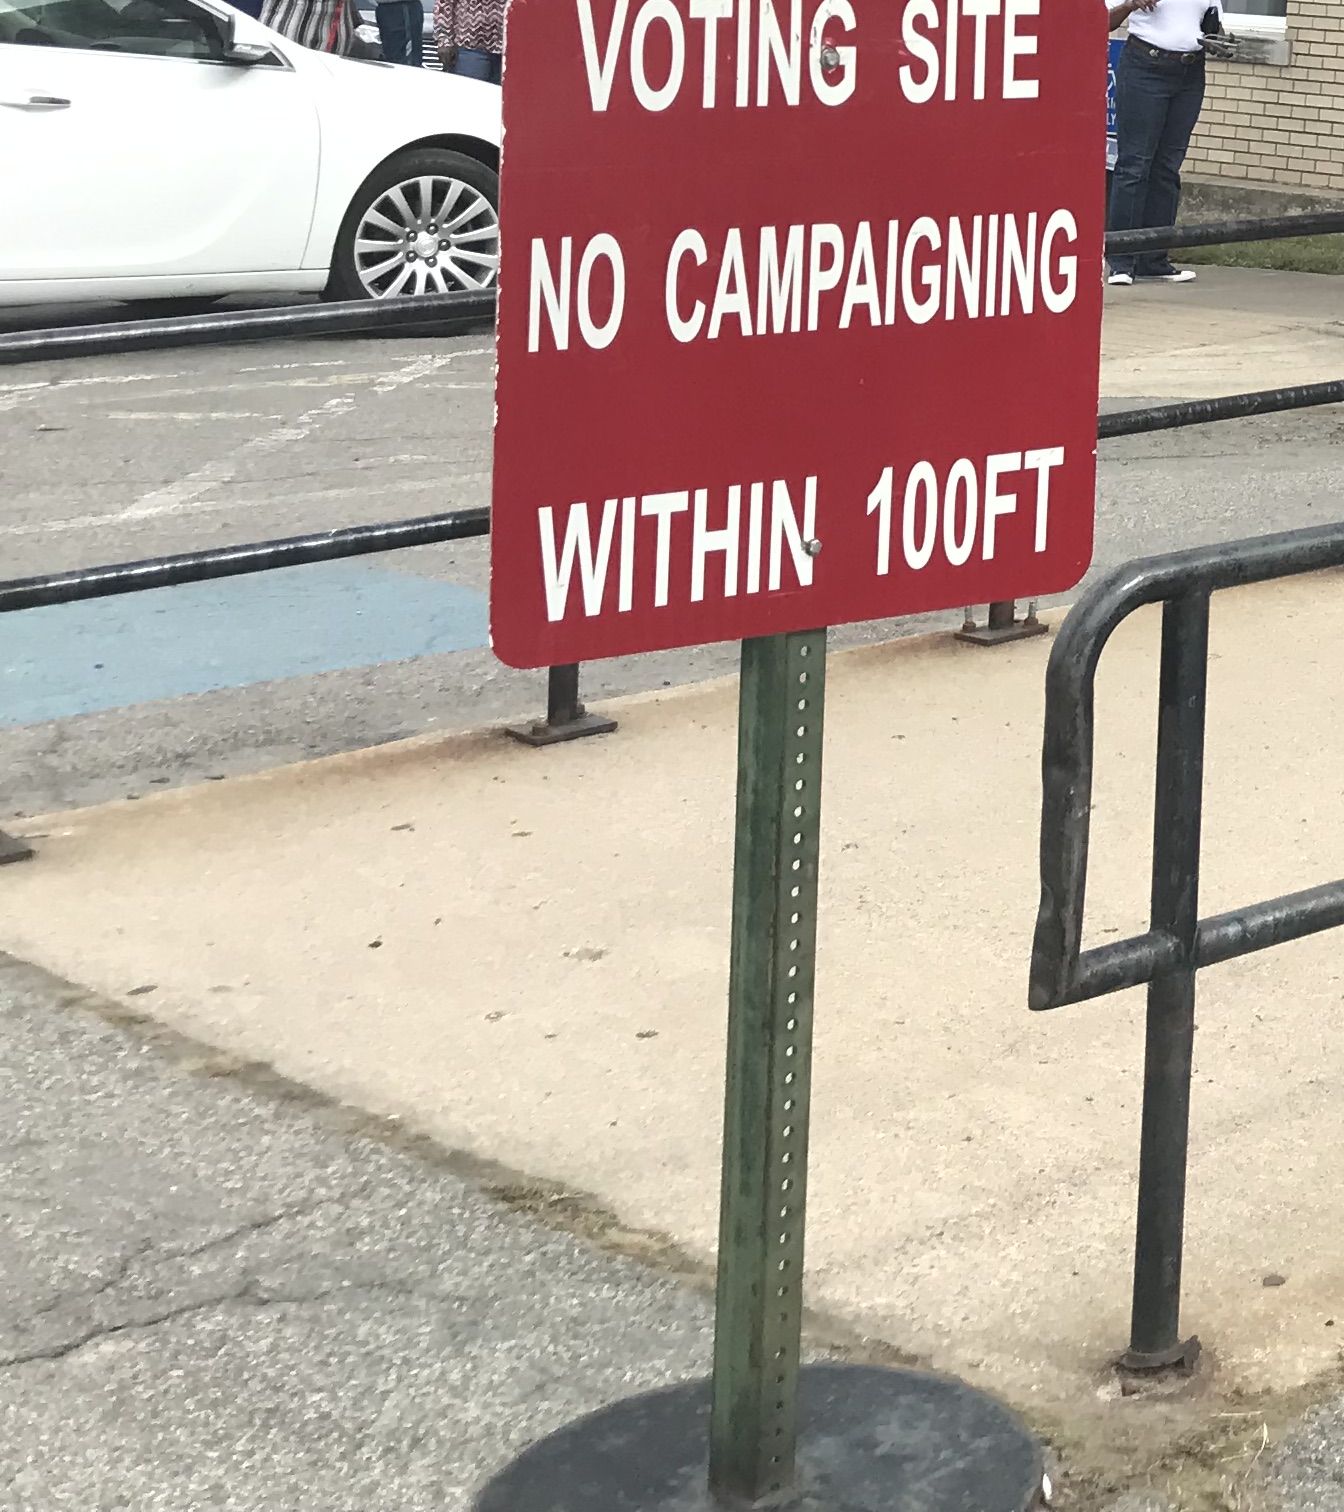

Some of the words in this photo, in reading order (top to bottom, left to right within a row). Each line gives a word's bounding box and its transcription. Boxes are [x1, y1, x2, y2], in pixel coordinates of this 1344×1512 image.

[528, 233, 625, 353] NO
[665, 208, 1078, 343] CAMPAIGNING
[538, 475, 818, 622] WITHIN
[866, 446, 1065, 575] 100FT
